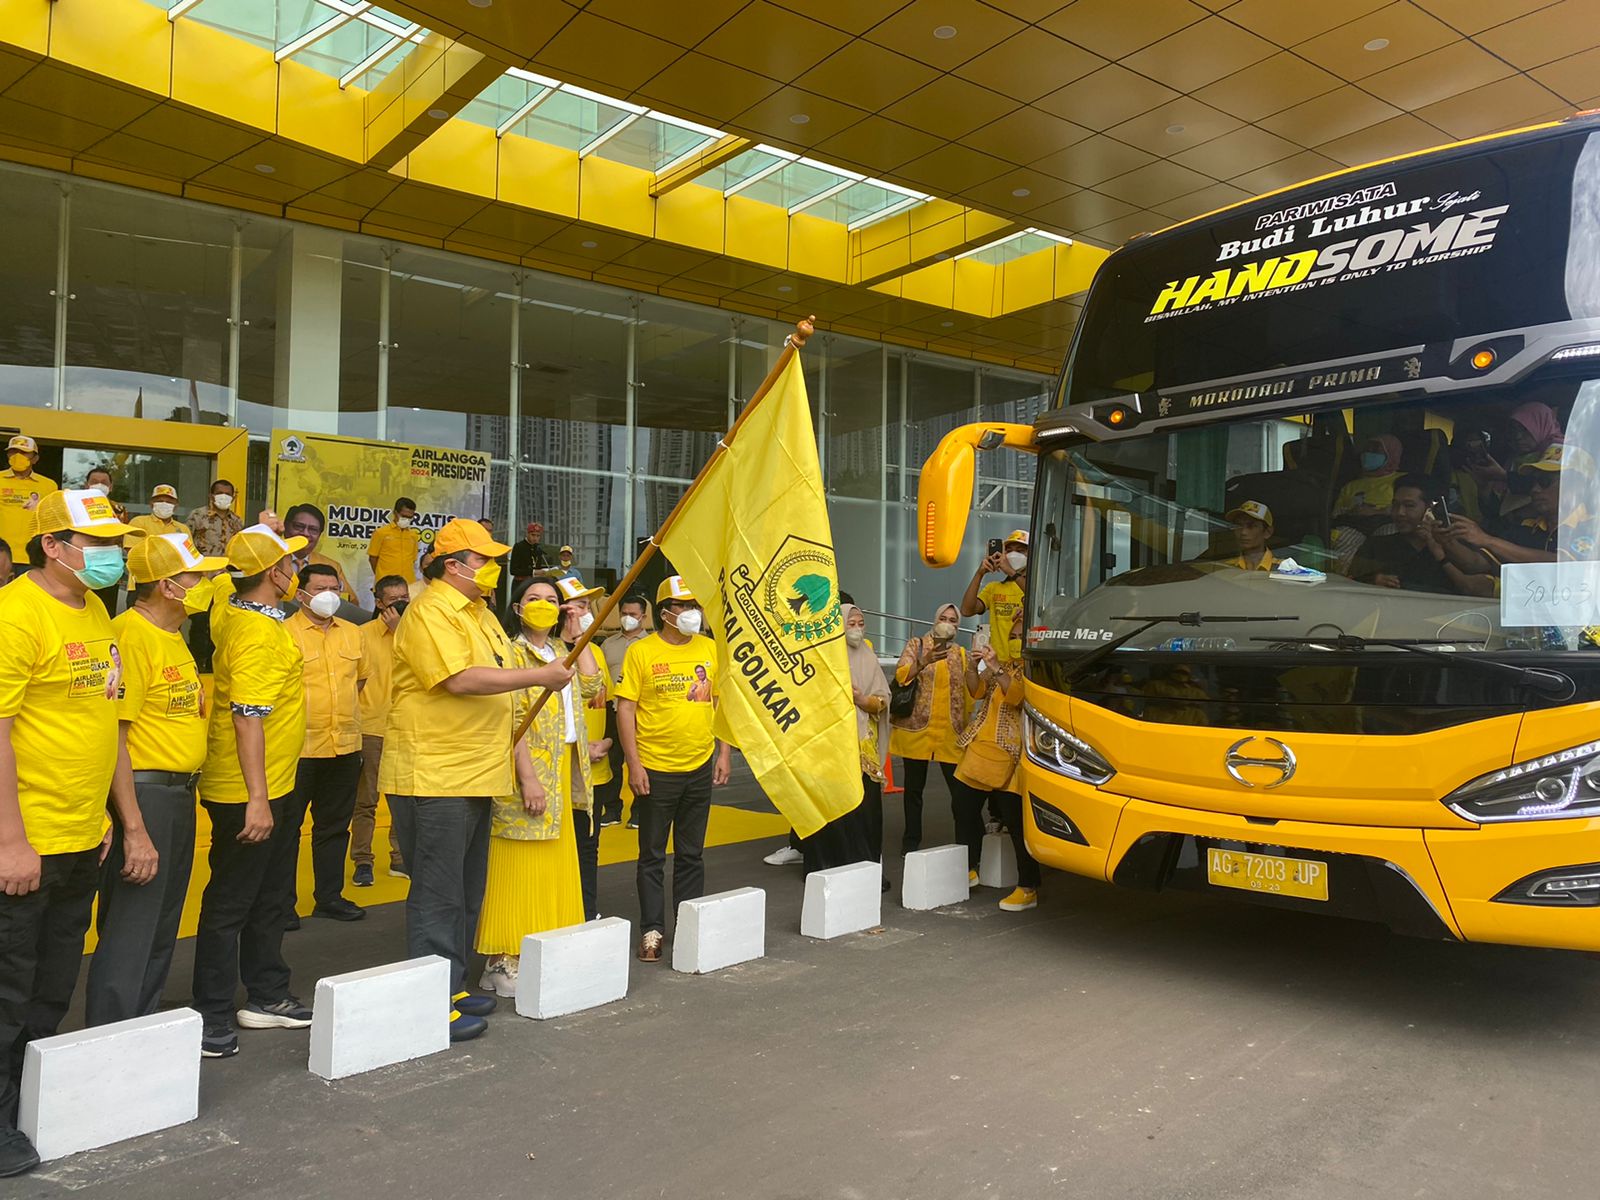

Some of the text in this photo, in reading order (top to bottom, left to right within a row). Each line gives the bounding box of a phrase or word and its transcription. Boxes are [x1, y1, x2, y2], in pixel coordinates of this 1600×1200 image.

[1255, 181, 1397, 231] PARIWISATA
[1216, 225, 1296, 262] Budi
[1308, 196, 1431, 239] Luhur
[1150, 205, 1510, 315] HANDSOME
[1144, 244, 1494, 324] BISMILLAH, MY INTENTION IS ONLY TO WORSHIP
[1308, 366, 1382, 390] PRIMA
[411, 448, 487, 467] AIRLANGGA
[411, 459, 430, 469] FOR
[410, 462, 487, 482] 2024 PRESIDENT
[328, 505, 457, 528] MUDIK RATI
[328, 522, 382, 539] BARE
[739, 592, 790, 670] GOLONGAN KARYA
[1074, 627, 1114, 641] Ma'e
[733, 641, 801, 733] GOLKAR
[1213, 852, 1320, 885] AG 7203 UP
